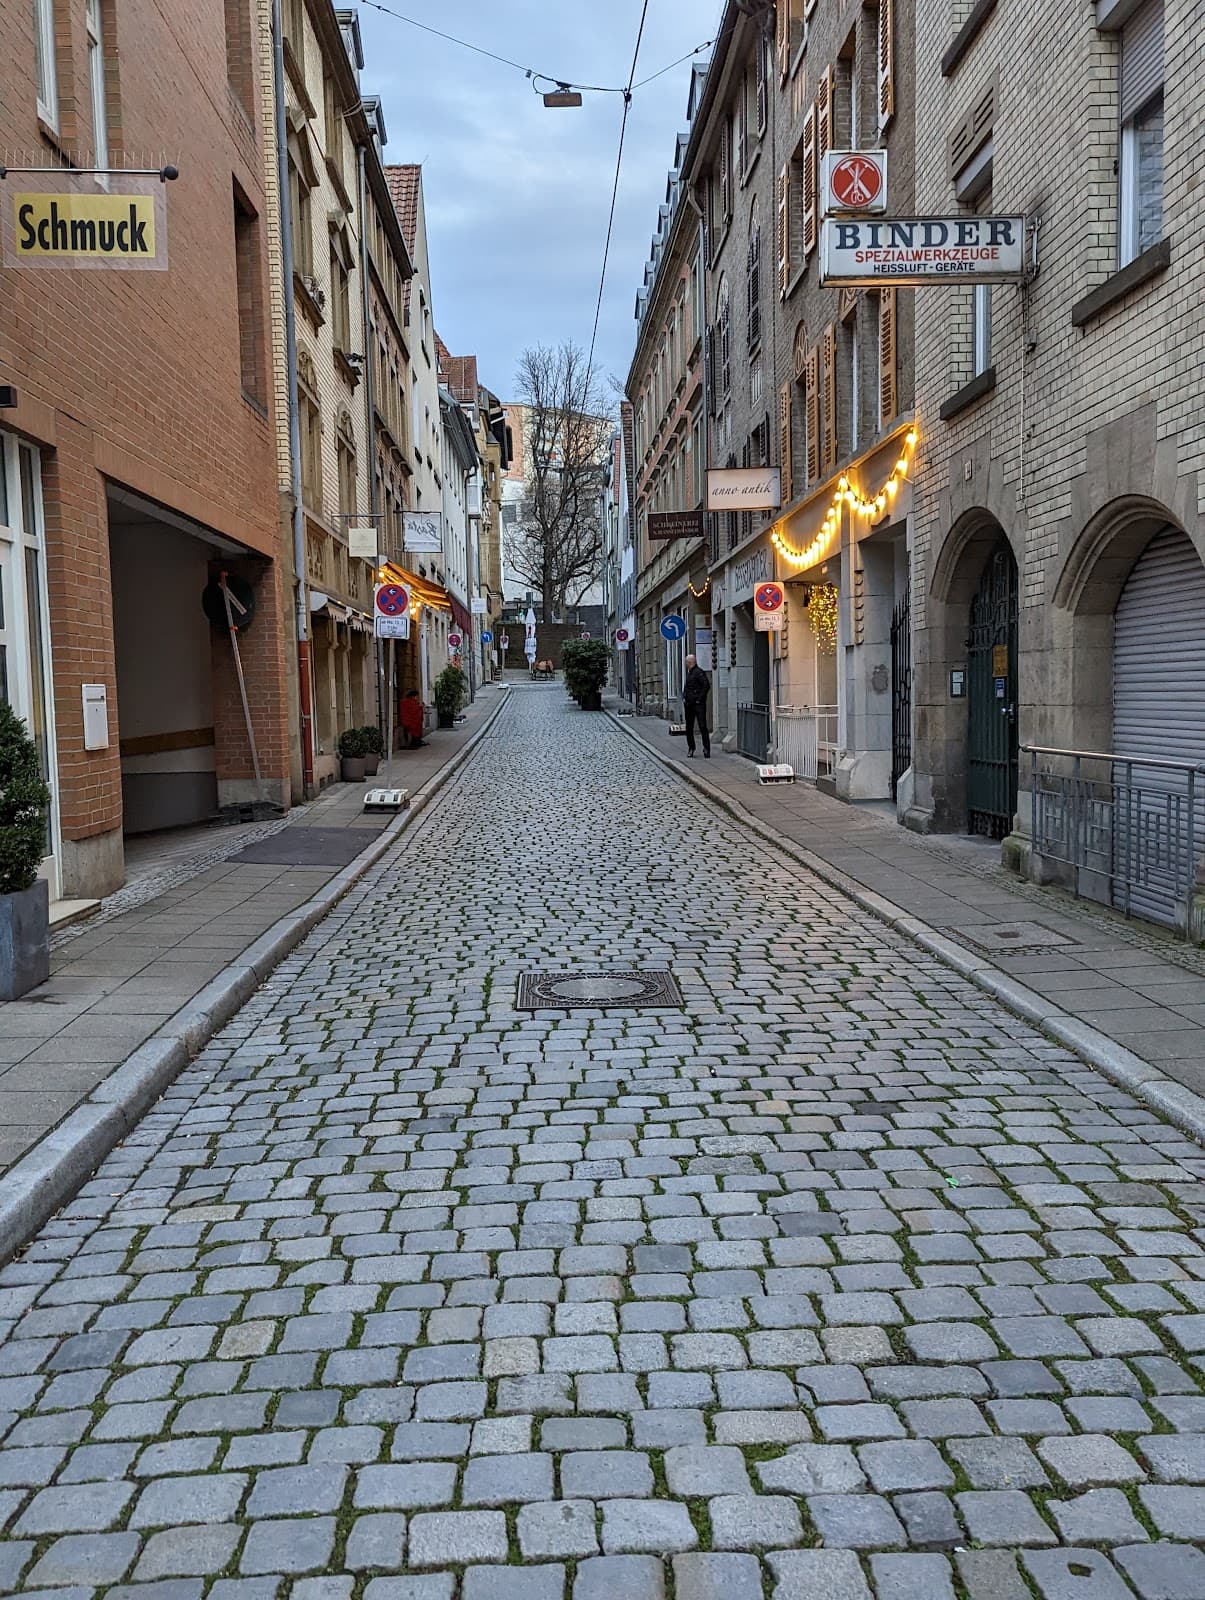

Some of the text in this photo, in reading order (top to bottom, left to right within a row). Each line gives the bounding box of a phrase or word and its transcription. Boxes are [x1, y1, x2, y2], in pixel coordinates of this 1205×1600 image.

[18, 201, 148, 252] Schmuck
[835, 220, 1016, 250] BINDER
[855, 248, 999, 263] SPEZIALWERKZEUGE
[711, 476, 778, 496] anno antik
